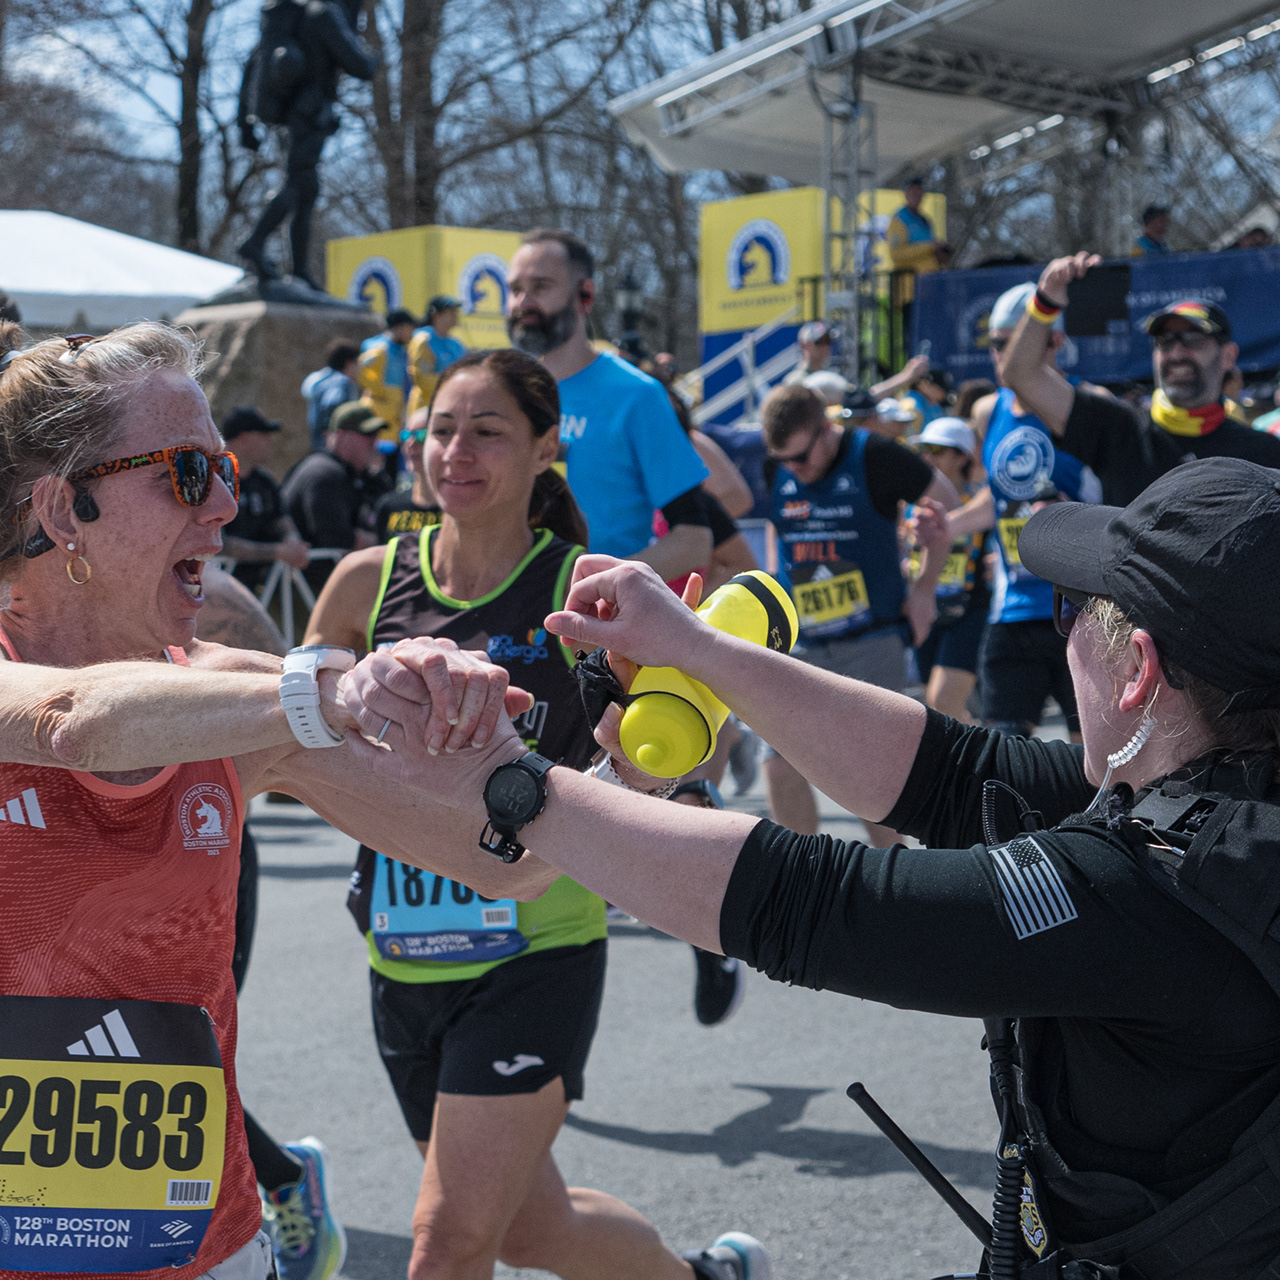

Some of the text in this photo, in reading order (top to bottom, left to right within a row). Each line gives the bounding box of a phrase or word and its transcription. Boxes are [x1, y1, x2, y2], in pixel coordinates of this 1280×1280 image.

[427, 934, 469, 945] BOSTON
[408, 944, 474, 956] MARATHON
[14, 1216, 130, 1232] 128TH BOSTON
